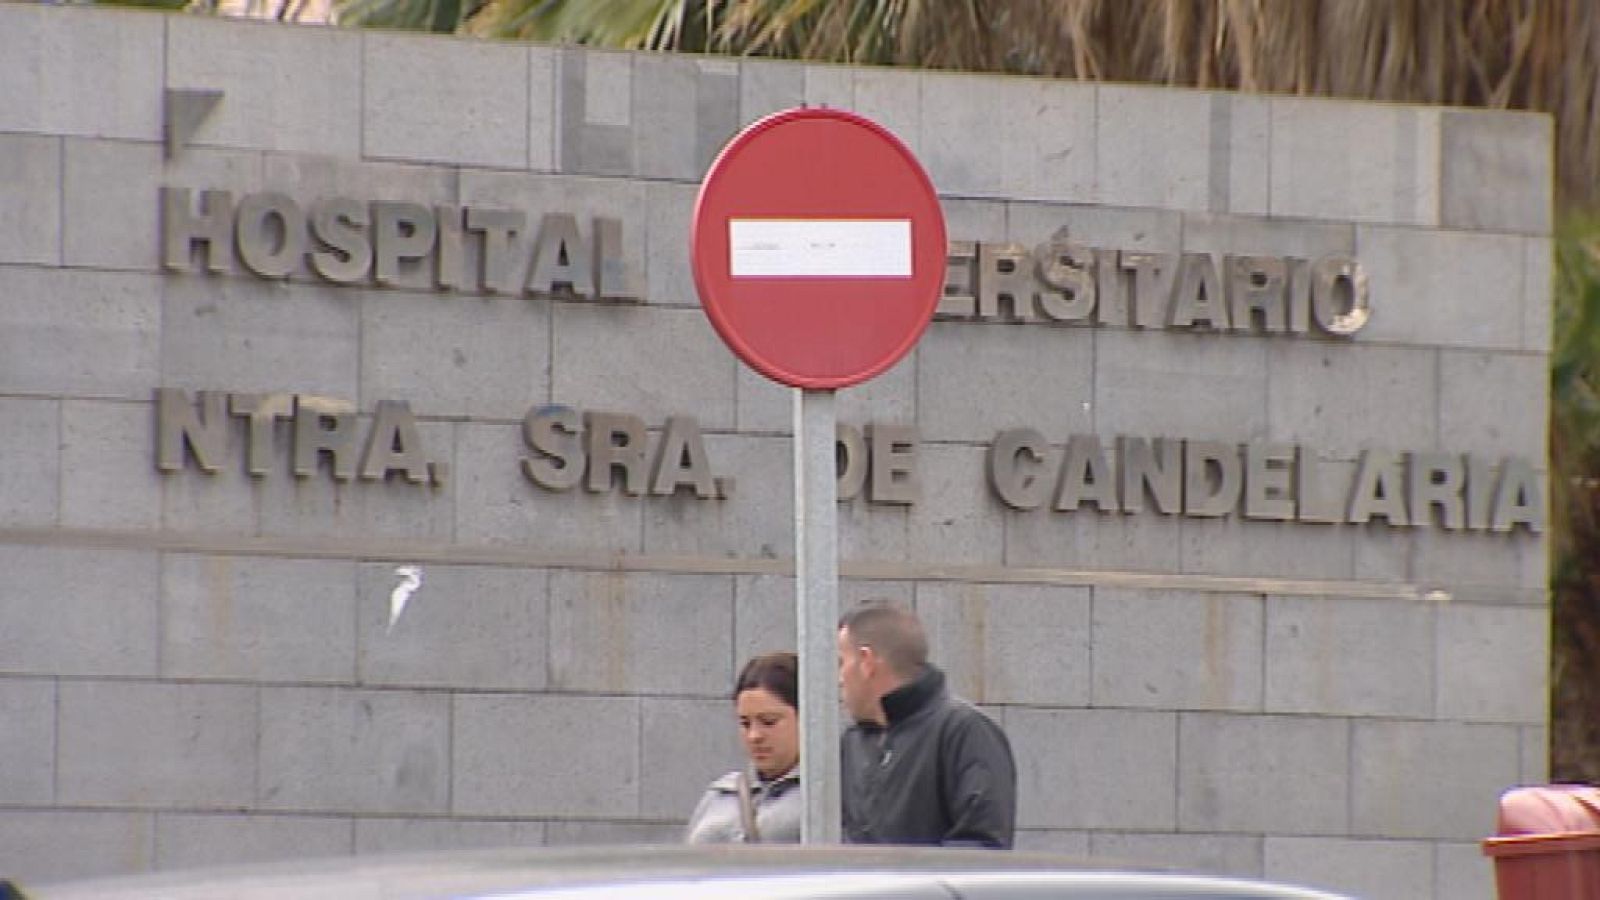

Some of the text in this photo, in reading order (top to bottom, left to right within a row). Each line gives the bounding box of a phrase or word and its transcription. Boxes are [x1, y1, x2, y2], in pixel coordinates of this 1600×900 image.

[161, 187, 1370, 337] HOSPITAL ERSITARIO
[154, 387, 448, 487] NTRA.
[521, 403, 736, 500] SRA.
[987, 427, 1542, 534] CANDELARIA
